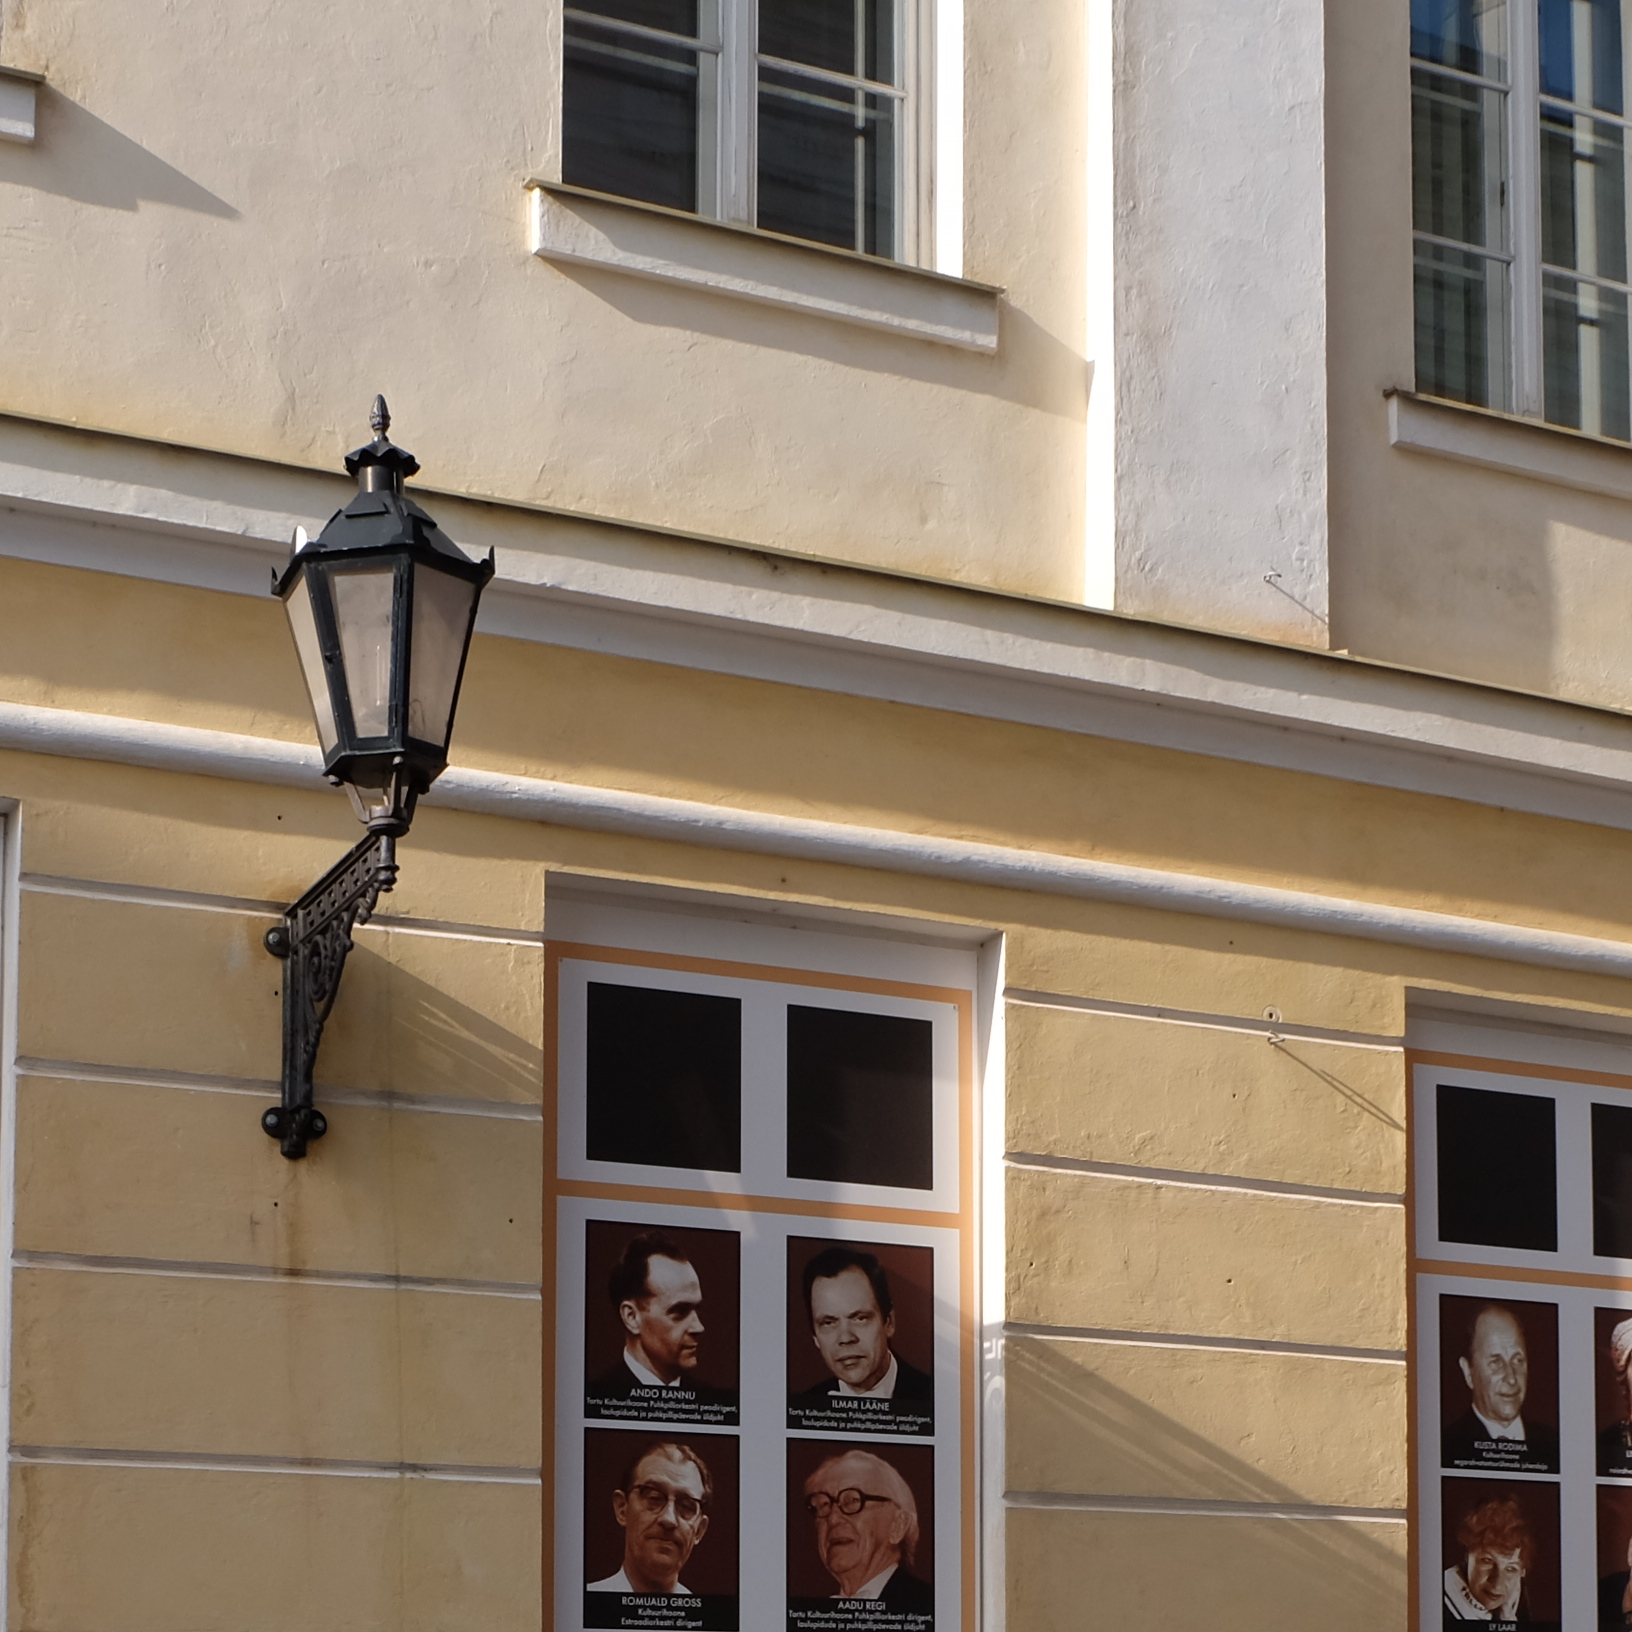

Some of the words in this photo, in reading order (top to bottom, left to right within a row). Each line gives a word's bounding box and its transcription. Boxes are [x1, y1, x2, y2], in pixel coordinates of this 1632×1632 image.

[630, 1388, 659, 1398] ANDO
[662, 1390, 696, 1399] RANNU
[832, 1400, 858, 1409] ILMAR
[861, 1400, 890, 1411] LÄÄNE
[789, 1408, 804, 1416] Tartu
[622, 1596, 667, 1606] ROMUALD
[670, 1598, 702, 1607] GROSS
[866, 1602, 886, 1610] REGI
[789, 1610, 805, 1618] Tartu
[676, 1619, 702, 1628] dirigent
